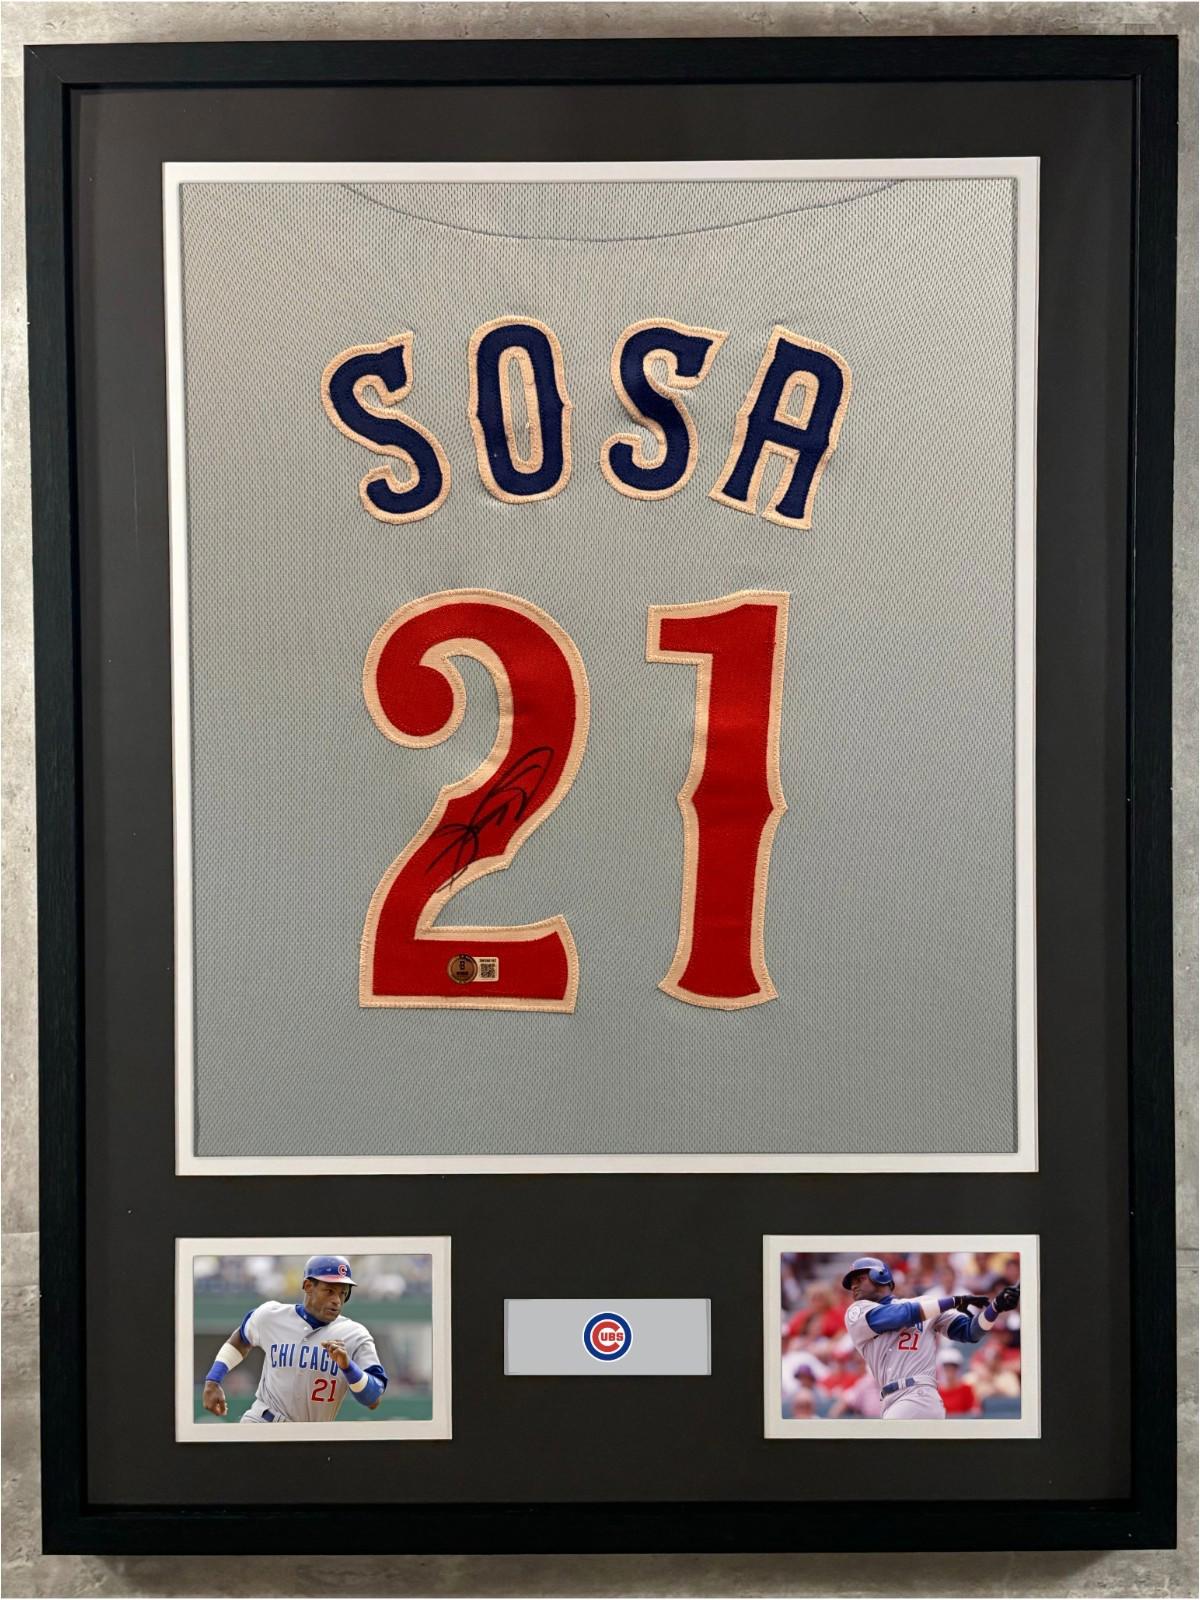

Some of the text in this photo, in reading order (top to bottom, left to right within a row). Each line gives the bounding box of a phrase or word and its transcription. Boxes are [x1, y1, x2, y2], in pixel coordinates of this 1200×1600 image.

[321, 315, 853, 530] SOSA
[360, 587, 791, 1013] 21
[592, 1321, 624, 1352] CUBS
[897, 1331, 920, 1351] 21
[311, 1378, 337, 1403] 21
